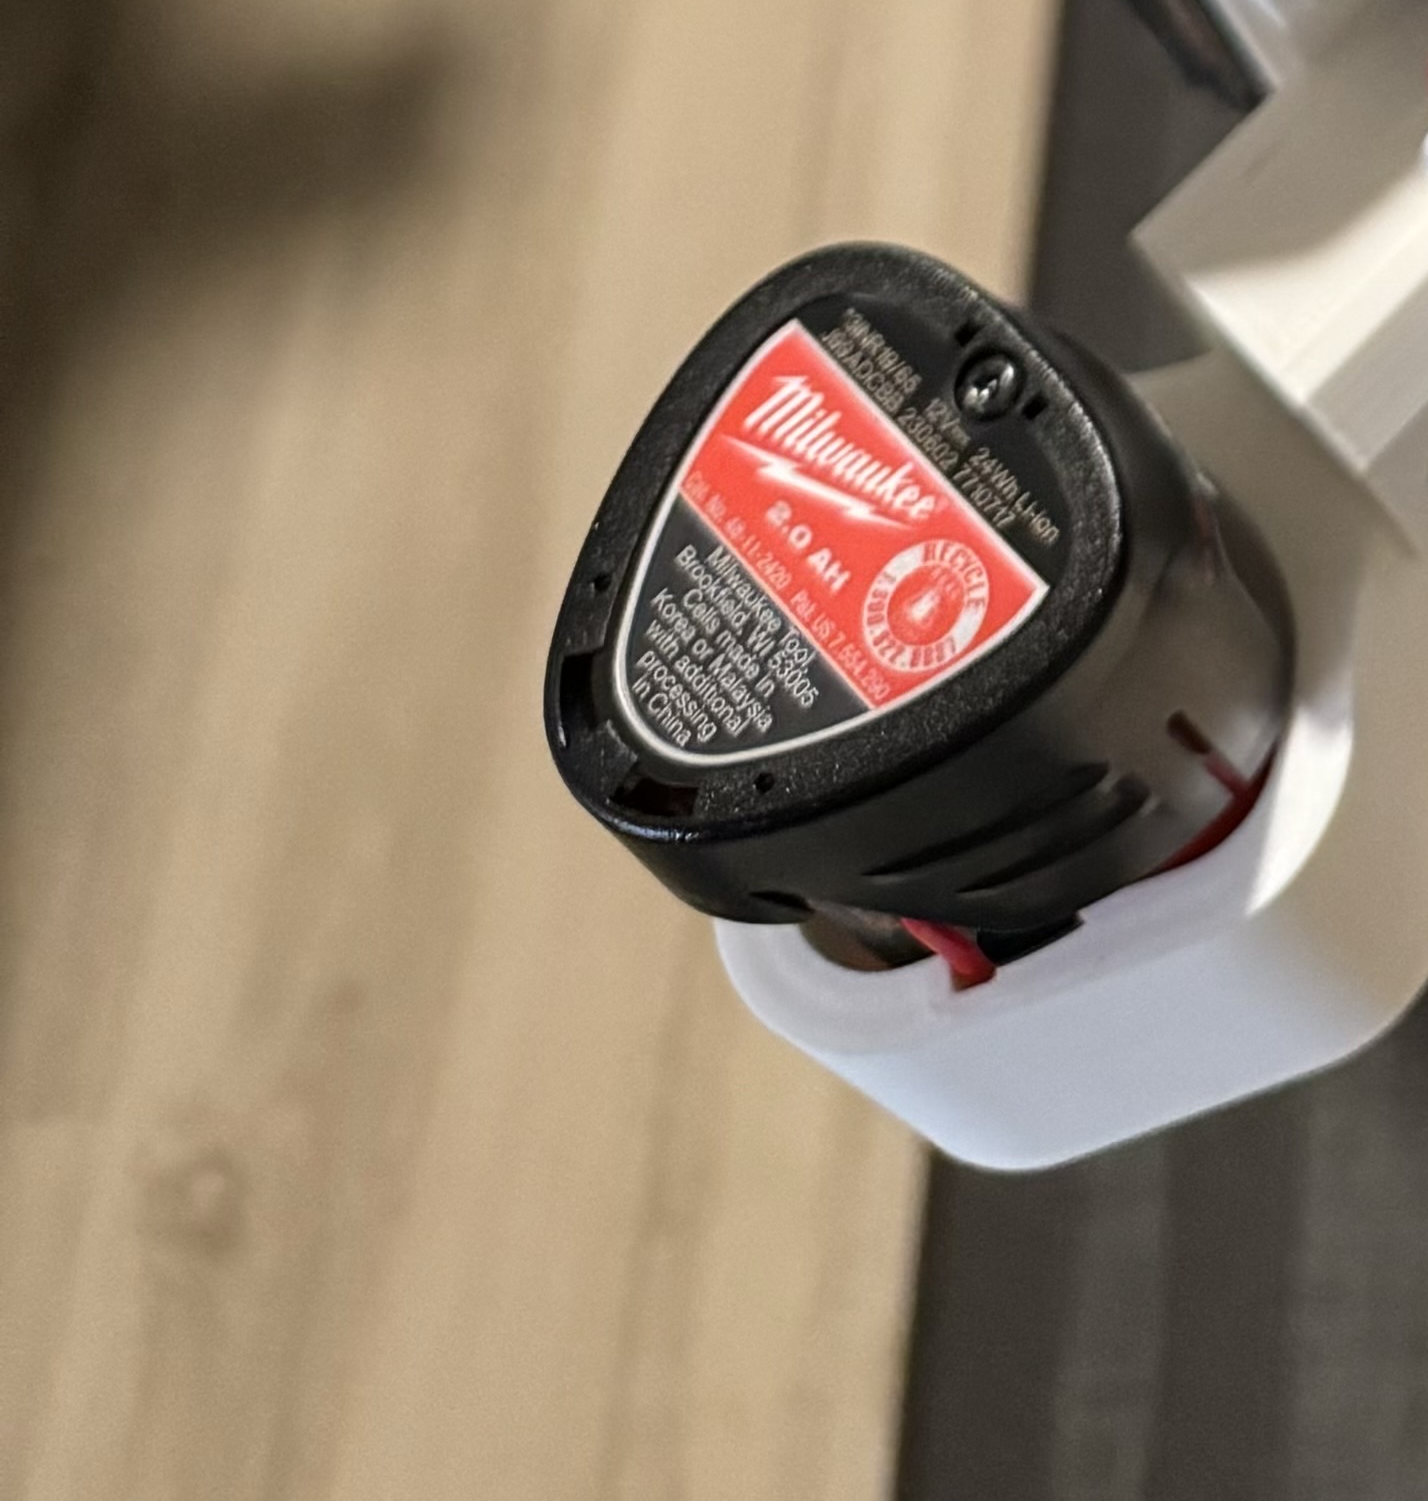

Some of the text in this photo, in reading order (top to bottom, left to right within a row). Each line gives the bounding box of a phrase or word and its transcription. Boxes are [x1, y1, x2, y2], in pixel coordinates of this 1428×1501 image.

[742, 374, 939, 522] Milwaukee
[968, 445, 1023, 501] 24Wh
[705, 545, 787, 634] Milwaukee
[761, 498, 853, 593] 2.0 AH
[923, 541, 985, 608] RECYCLE
[650, 587, 779, 734] Korea or Malaysia
[673, 543, 821, 710] Brookfield, WI 53005
[679, 586, 780, 698] Cells made in
[809, 611, 837, 640] US
[629, 674, 696, 748] in China
[634, 649, 720, 744] processing
[643, 618, 751, 738] with additional
